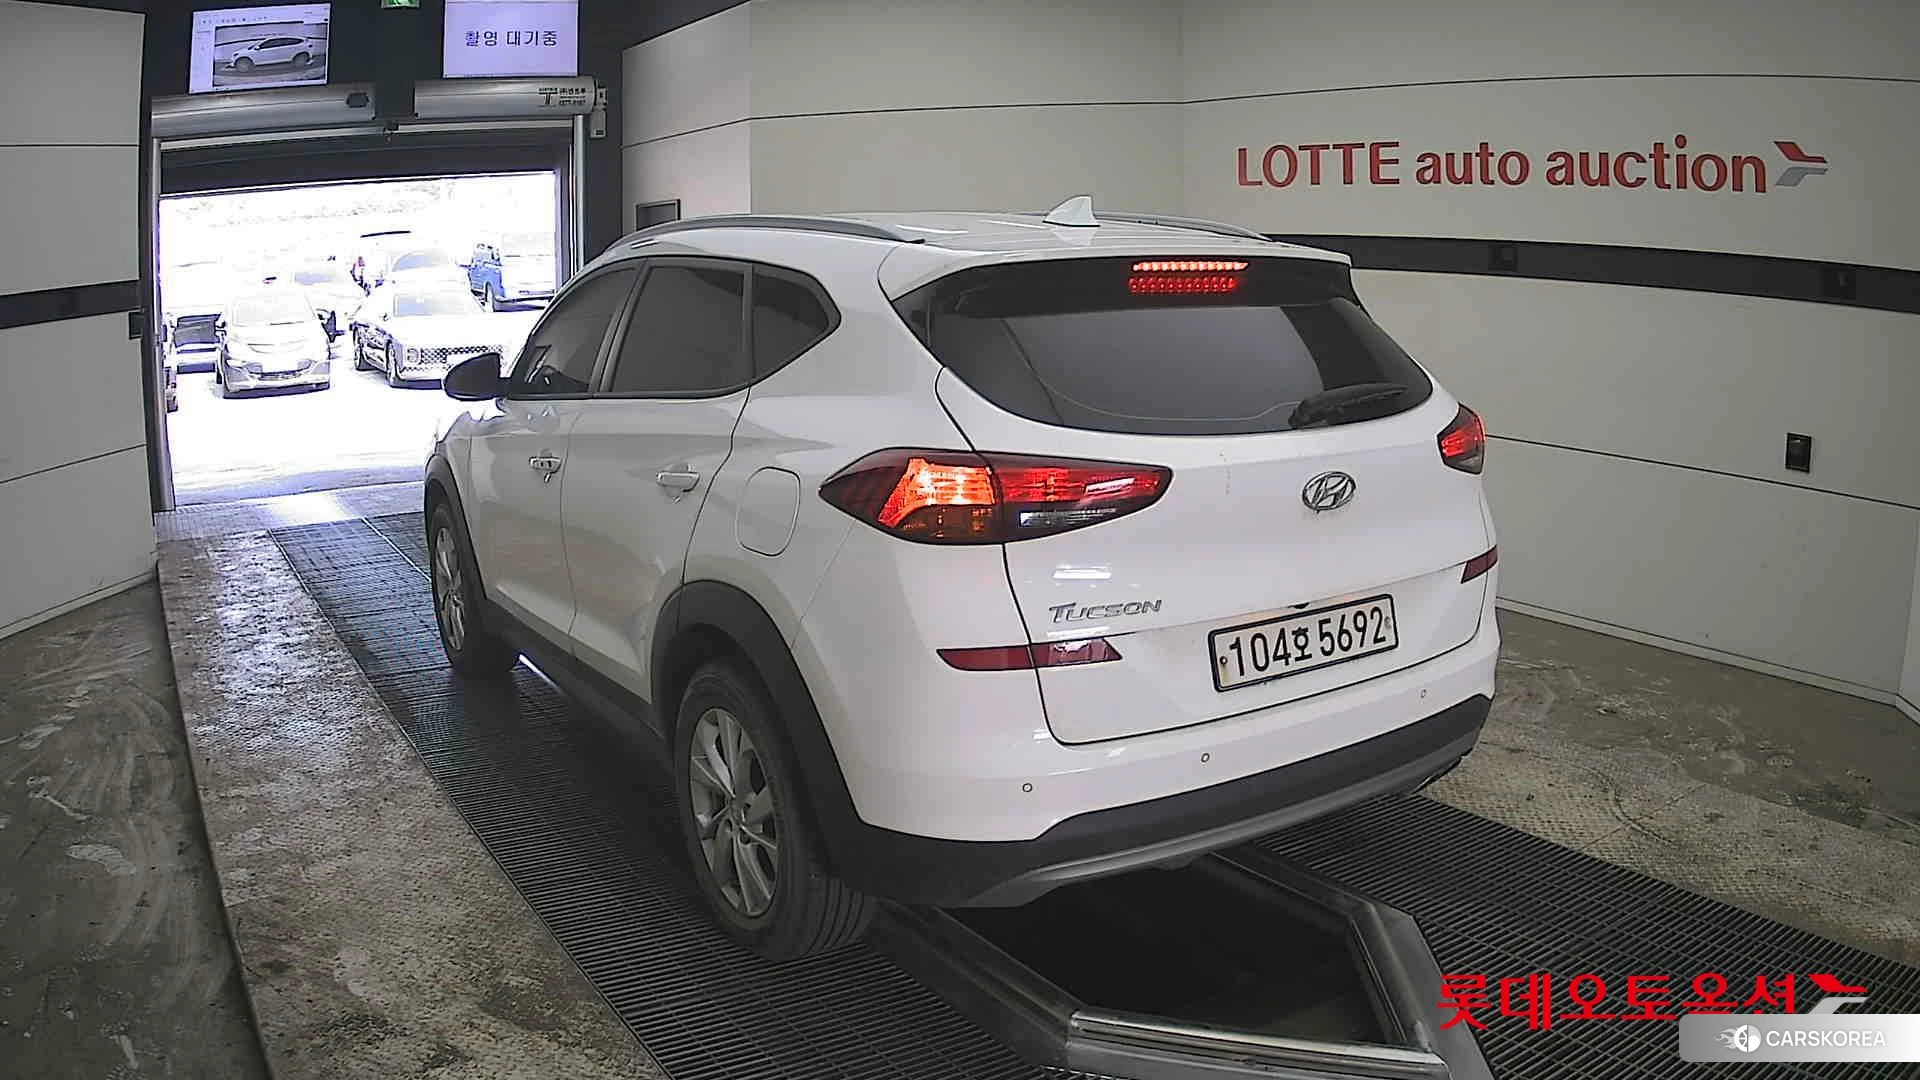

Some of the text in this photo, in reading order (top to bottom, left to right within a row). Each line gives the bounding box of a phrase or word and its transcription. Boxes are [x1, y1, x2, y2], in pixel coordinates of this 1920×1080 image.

[465, 30, 558, 47] 촬영 대기중
[1237, 134, 1767, 194] LOTTE auto auction
[1048, 599, 1162, 623] TUCSON
[1317, 606, 1387, 657] 5692
